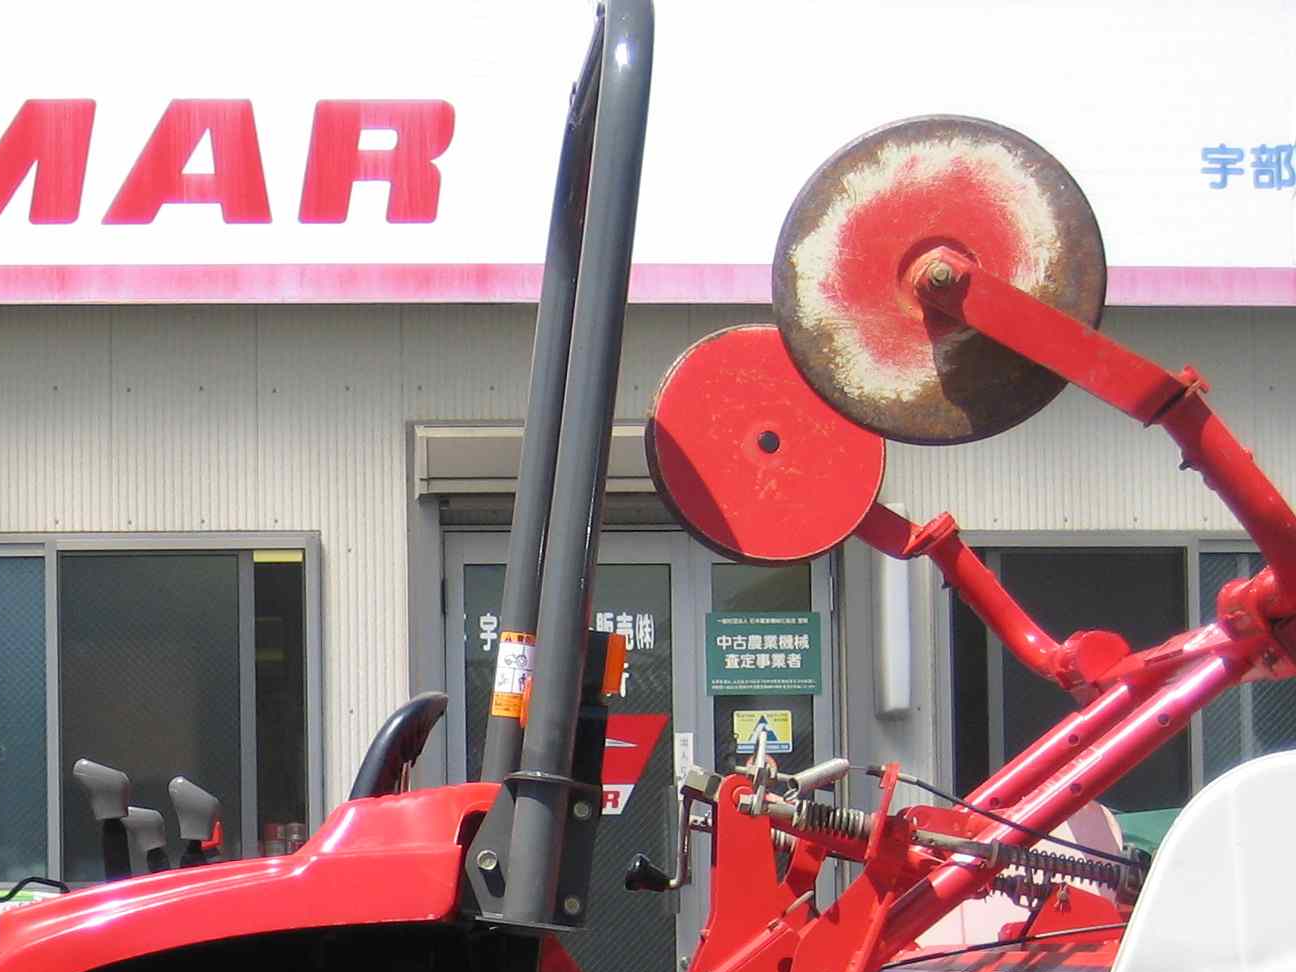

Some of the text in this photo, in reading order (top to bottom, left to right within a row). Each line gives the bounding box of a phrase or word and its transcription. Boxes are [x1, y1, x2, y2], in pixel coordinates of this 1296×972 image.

[1200, 143, 1296, 190] 宇部
[716, 634, 810, 650] 中古農業機械
[725, 653, 802, 669] 査定事業者
